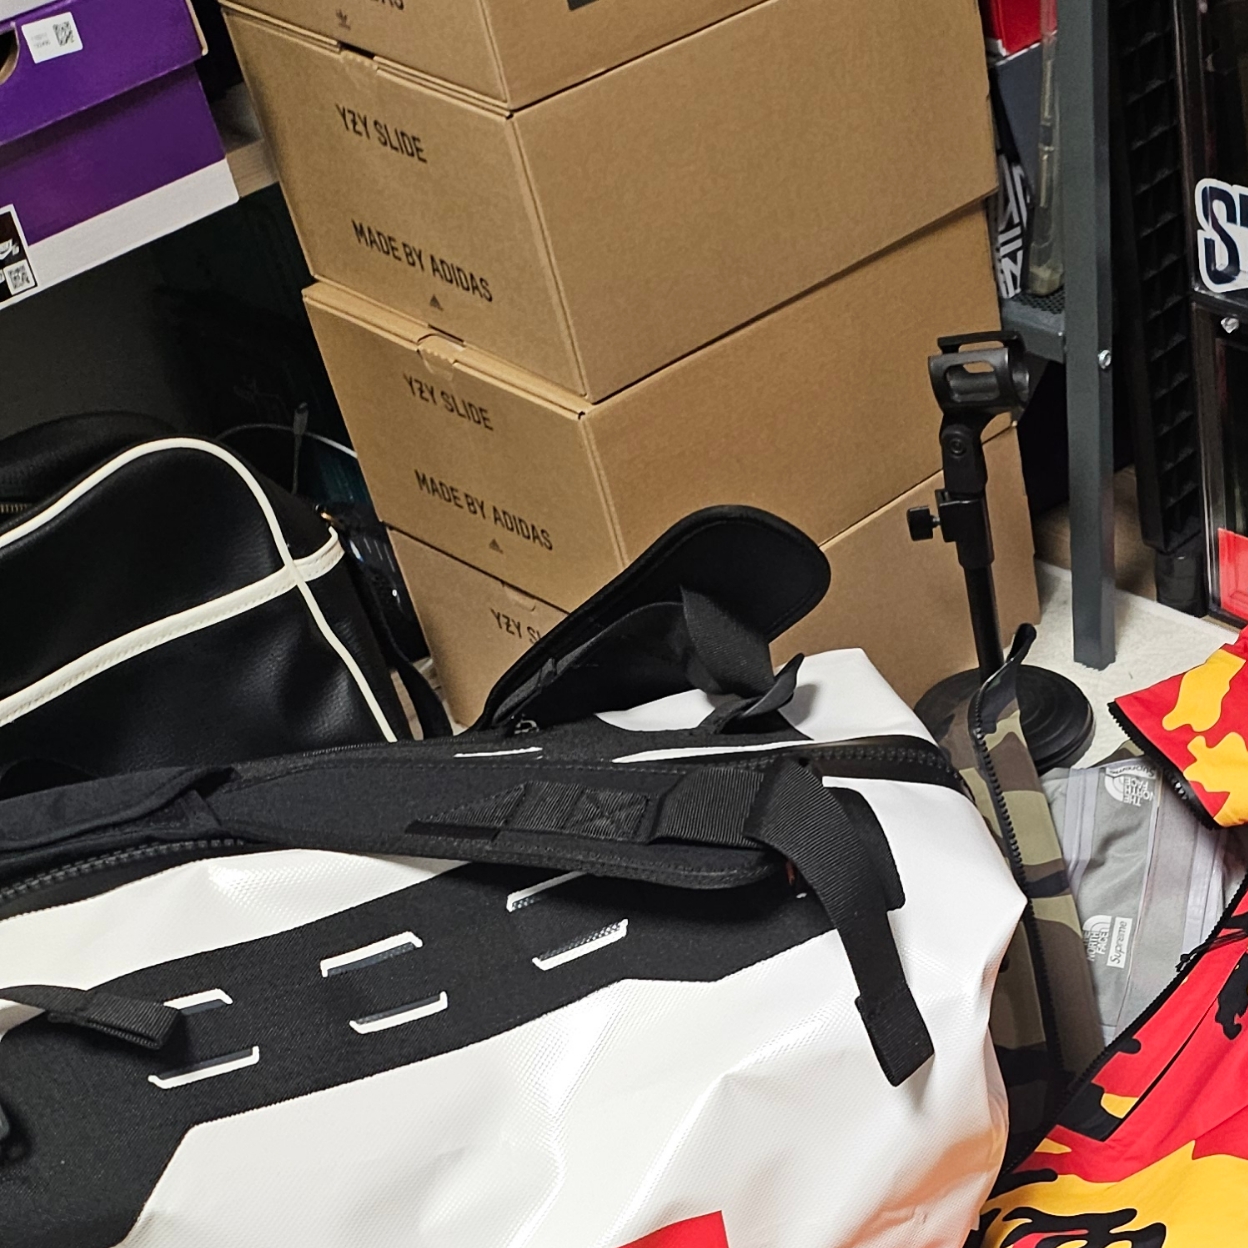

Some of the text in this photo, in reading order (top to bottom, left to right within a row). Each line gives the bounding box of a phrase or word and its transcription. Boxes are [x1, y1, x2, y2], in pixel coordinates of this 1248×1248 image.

[335, 103, 427, 164] YZY SLIDE
[352, 219, 493, 302] MADE BY ADIDAS
[403, 373, 494, 431] YZY SLIDE
[414, 469, 553, 551] MADE BY ADIDAS
[490, 608, 523, 639] YZY
[1123, 795, 1142, 807] THE
[1086, 932, 1100, 961] NORTH
[1095, 932, 1109, 954] FACE
[1109, 920, 1127, 964] Supreme
